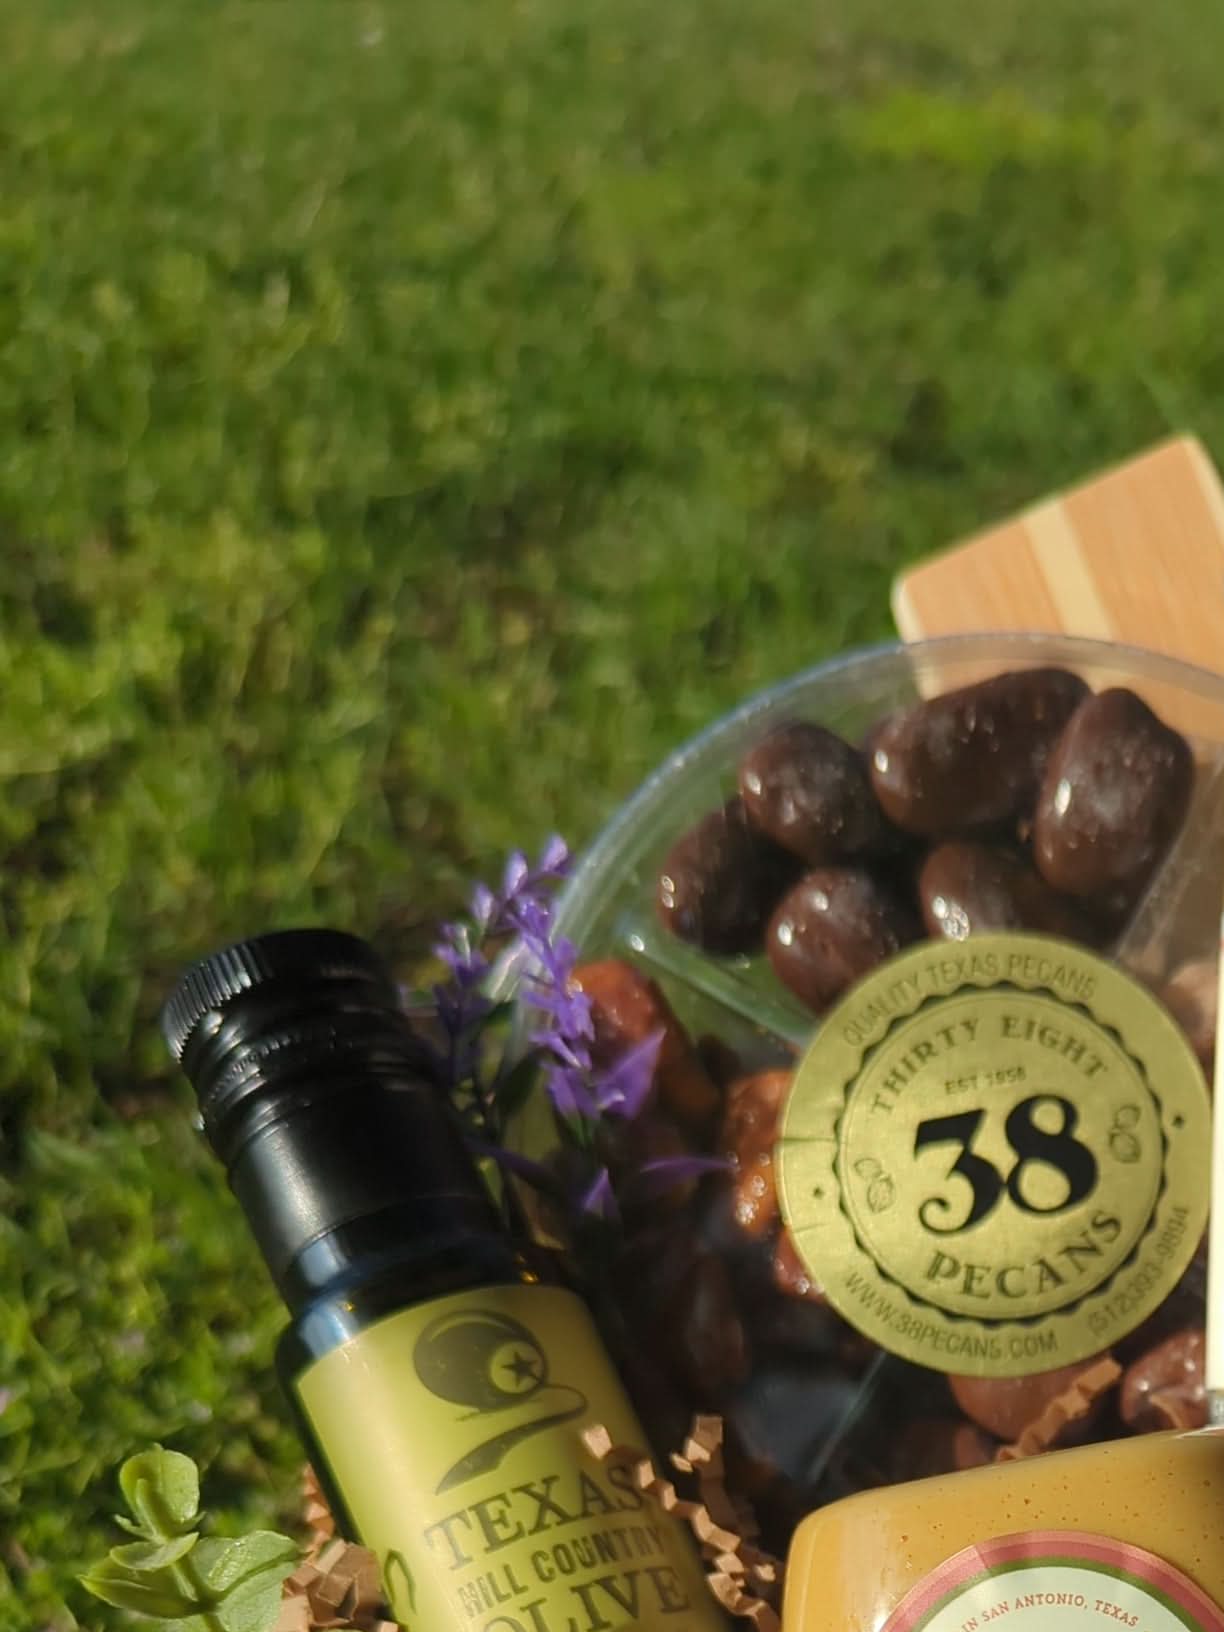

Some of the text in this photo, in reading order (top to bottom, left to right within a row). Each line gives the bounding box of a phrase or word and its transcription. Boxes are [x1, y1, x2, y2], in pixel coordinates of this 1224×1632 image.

[842, 953, 1096, 1047] QUALITY TEXAS PECANS
[873, 1014, 1109, 1115] THIRTY EIGHT
[914, 1094, 1099, 1237] 38
[925, 1209, 1122, 1299] PECANS
[424, 1463, 645, 1570] TEXAS
[530, 1526, 666, 1583] COUNTRY
[982, 1601, 1009, 1622] SAN
[1015, 1593, 1088, 1610] ANTONIO,
[1094, 1600, 1139, 1627] TEXAS
